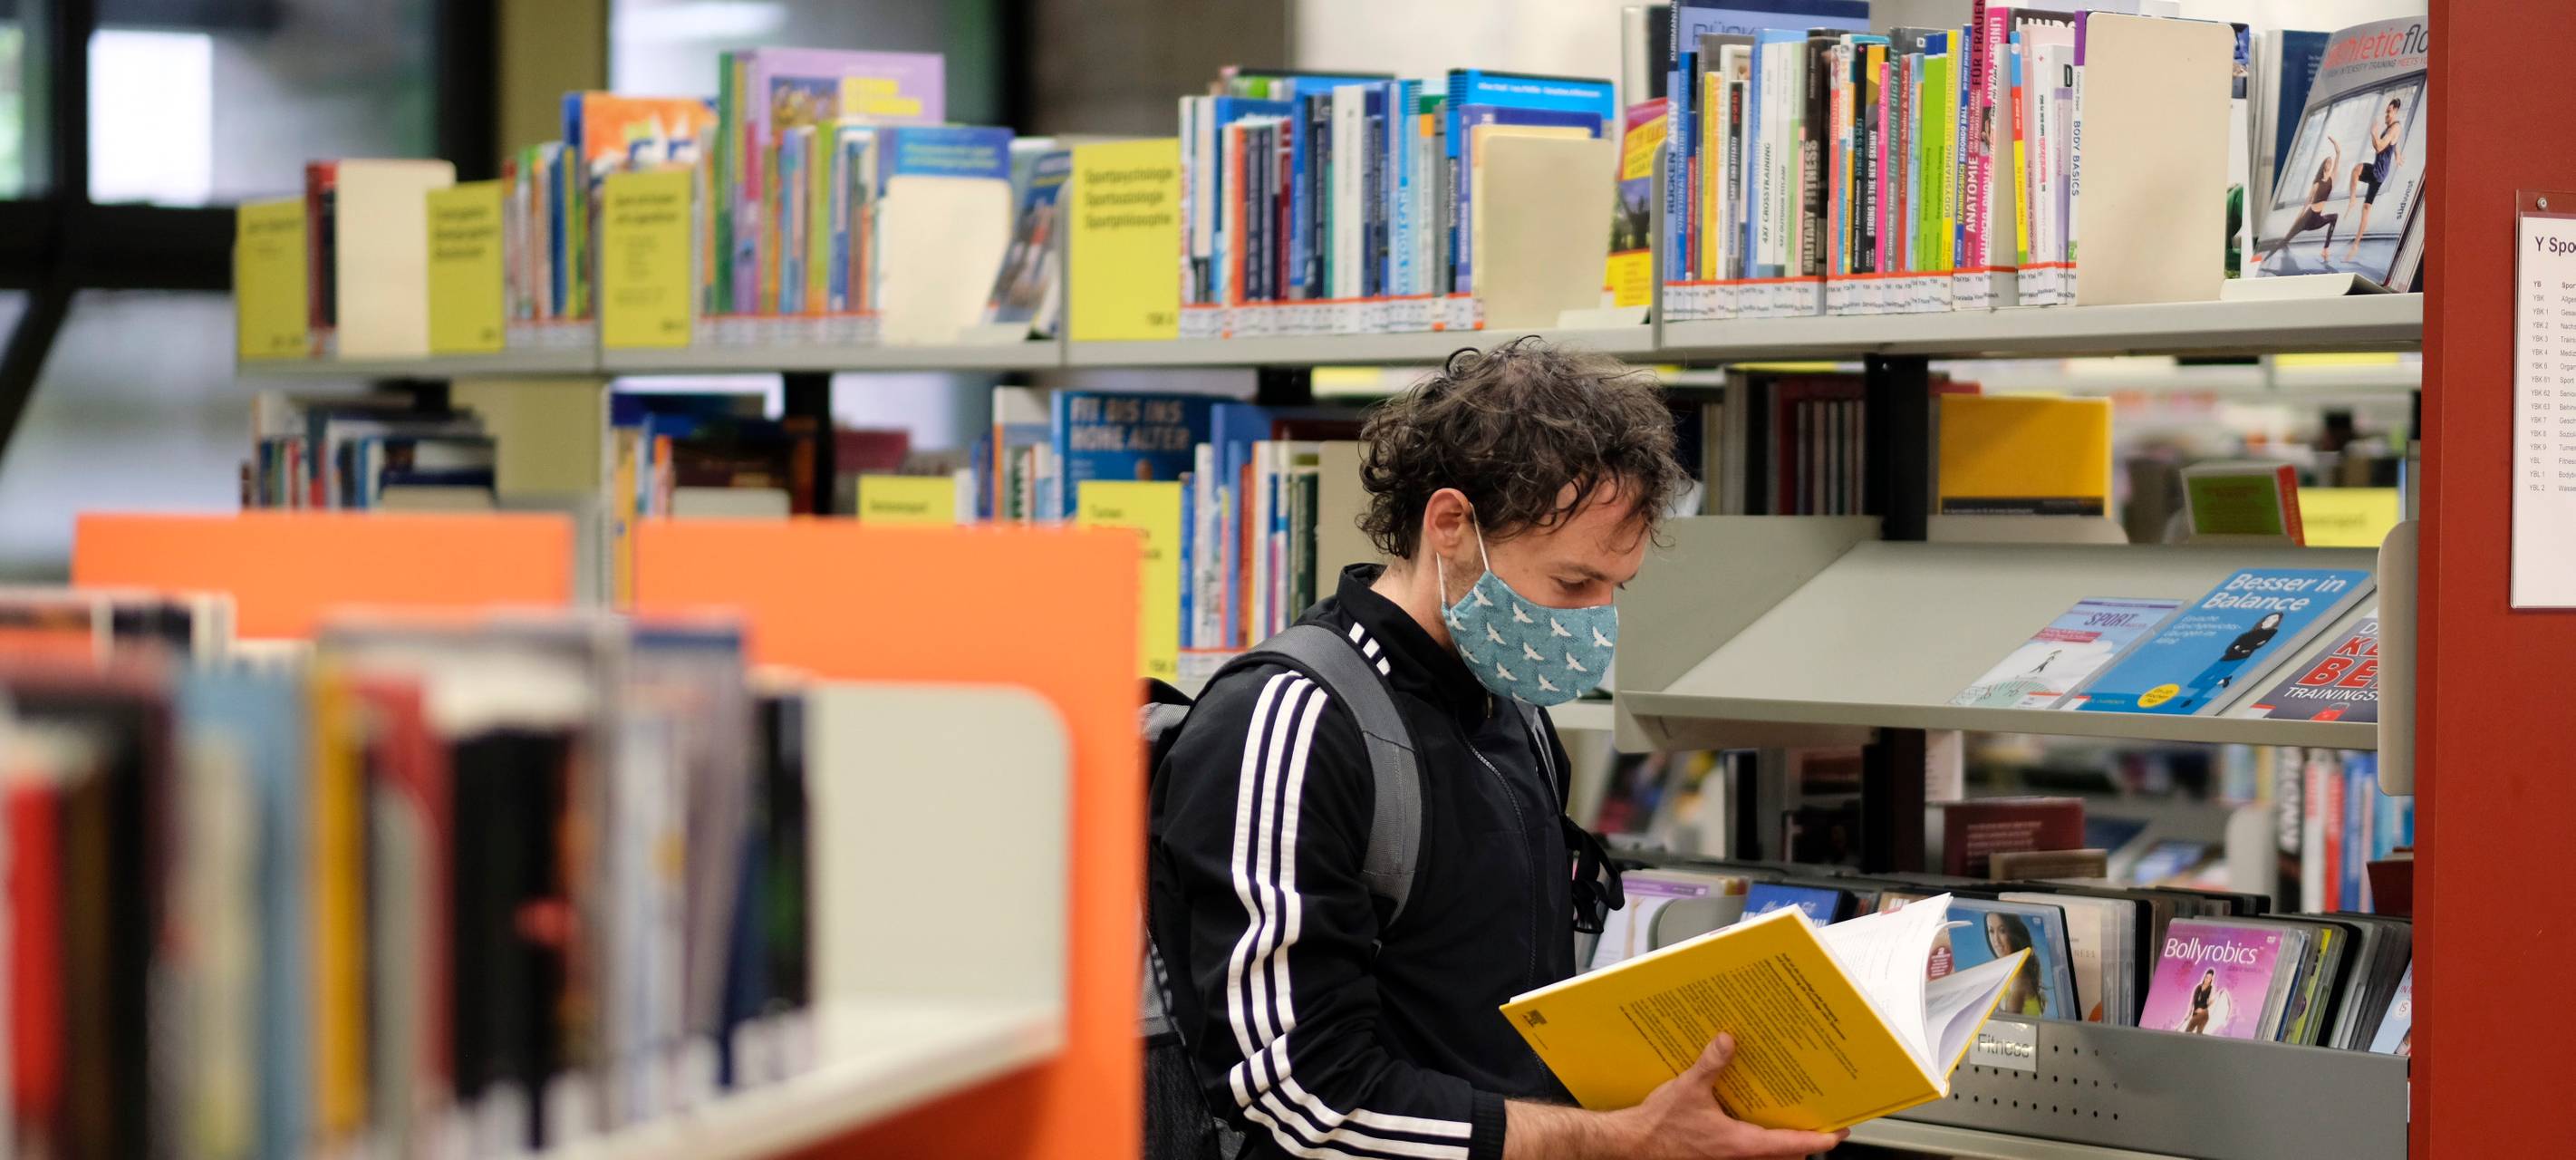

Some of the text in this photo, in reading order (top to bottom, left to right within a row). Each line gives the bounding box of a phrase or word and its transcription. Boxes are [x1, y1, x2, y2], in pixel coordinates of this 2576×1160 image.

[1972, 57, 1983, 86] FÜR
[1890, 76, 1898, 107] dich
[1889, 112, 1897, 151] mach
[2071, 121, 2081, 197] BODY BASICS
[1762, 142, 1771, 223] CROSSTRAINING
[1867, 130, 1878, 237] STRONG IS THE NEW SKINNY
[1944, 145, 1953, 218] BODYSHAPING
[1957, 164, 1965, 225] TRAININGSBUCH
[1966, 157, 1979, 233] ANATOMIE
[1803, 140, 1819, 273] MILITARY FITNESS
[2535, 236, 2576, 256] Y Spo
[1105, 398, 1140, 422] BIS
[1144, 401, 1183, 422] INS
[1127, 427, 1190, 450] ALTER
[2224, 573, 2347, 593] Besser in
[2202, 592, 2311, 611] Balance
[2084, 613, 2140, 626] SPORT
[2359, 622, 2378, 634] D
[2295, 655, 2378, 688] BE
[2284, 686, 2378, 701] TRAININGS
[2164, 937, 2258, 965] Bollyrobics
[1977, 1033, 2030, 1058] Fitness
